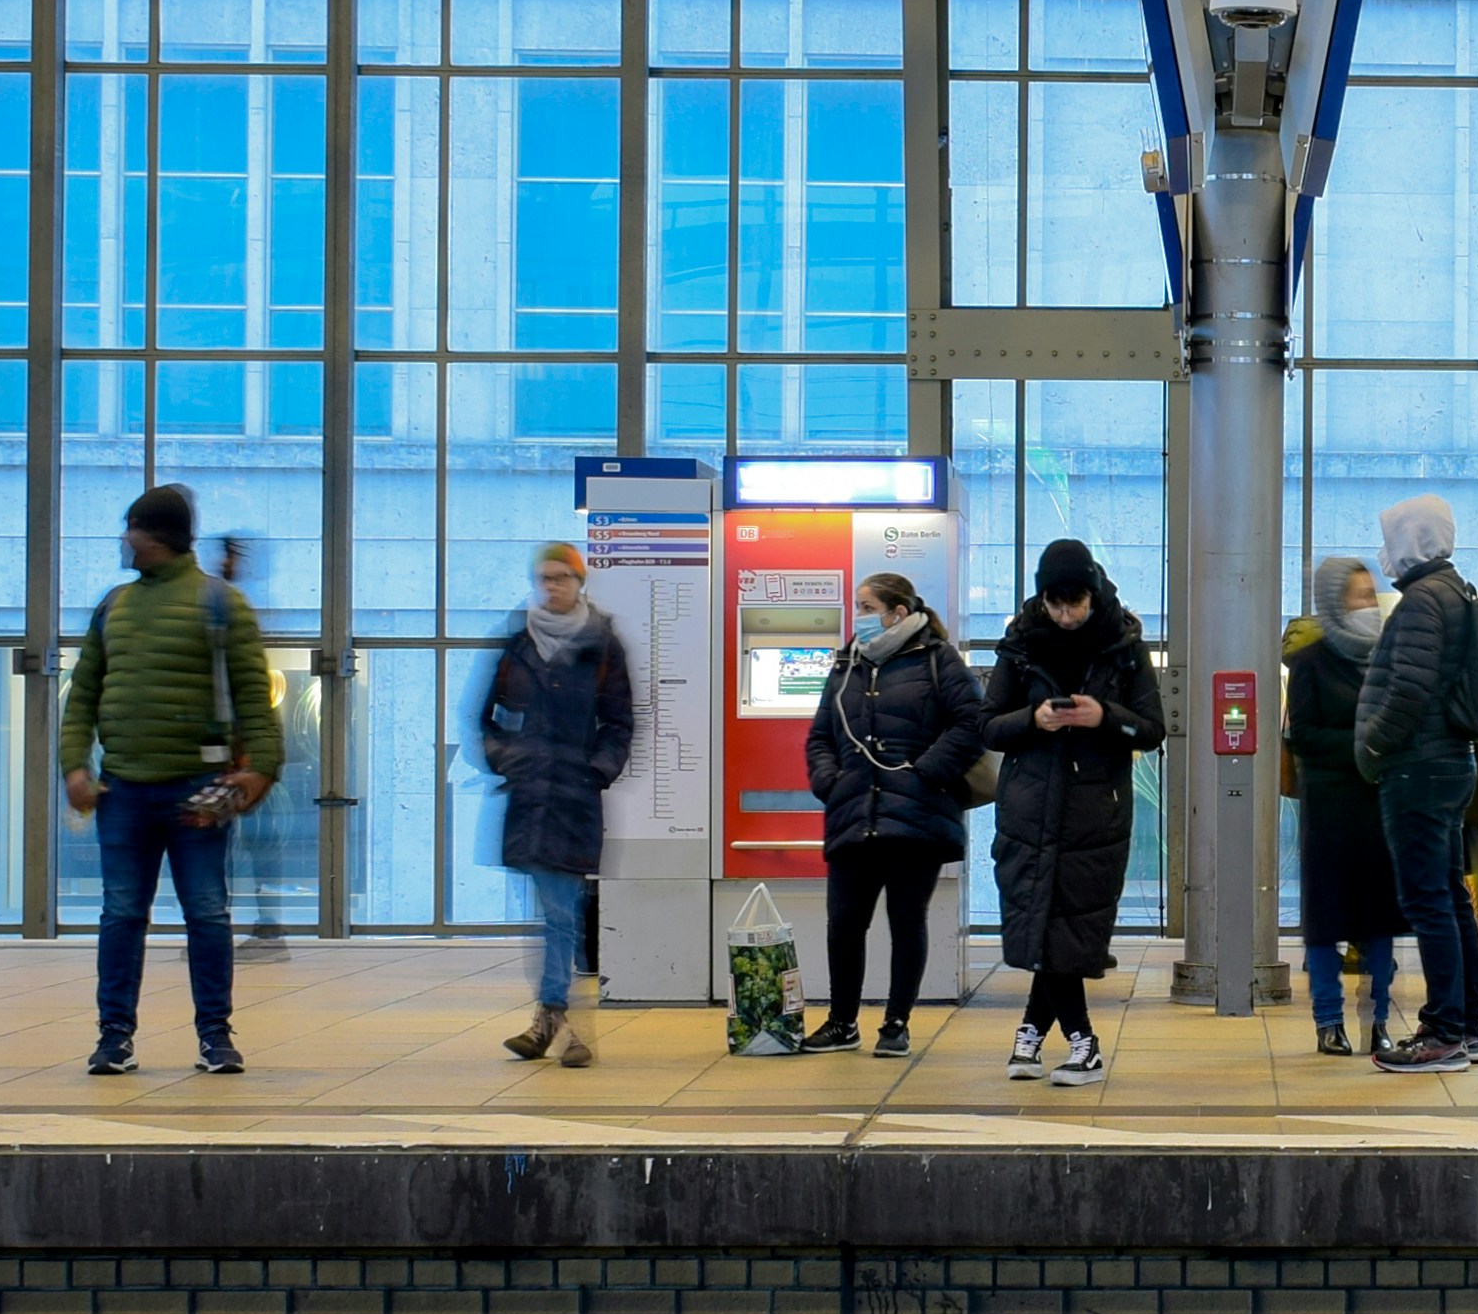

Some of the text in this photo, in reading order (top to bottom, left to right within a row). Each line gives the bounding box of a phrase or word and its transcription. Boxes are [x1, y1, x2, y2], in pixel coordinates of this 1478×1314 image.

[595, 530, 610, 540] S5
[739, 528, 756, 539] DB
[595, 544, 610, 554] S7
[595, 558, 610, 568] S9
